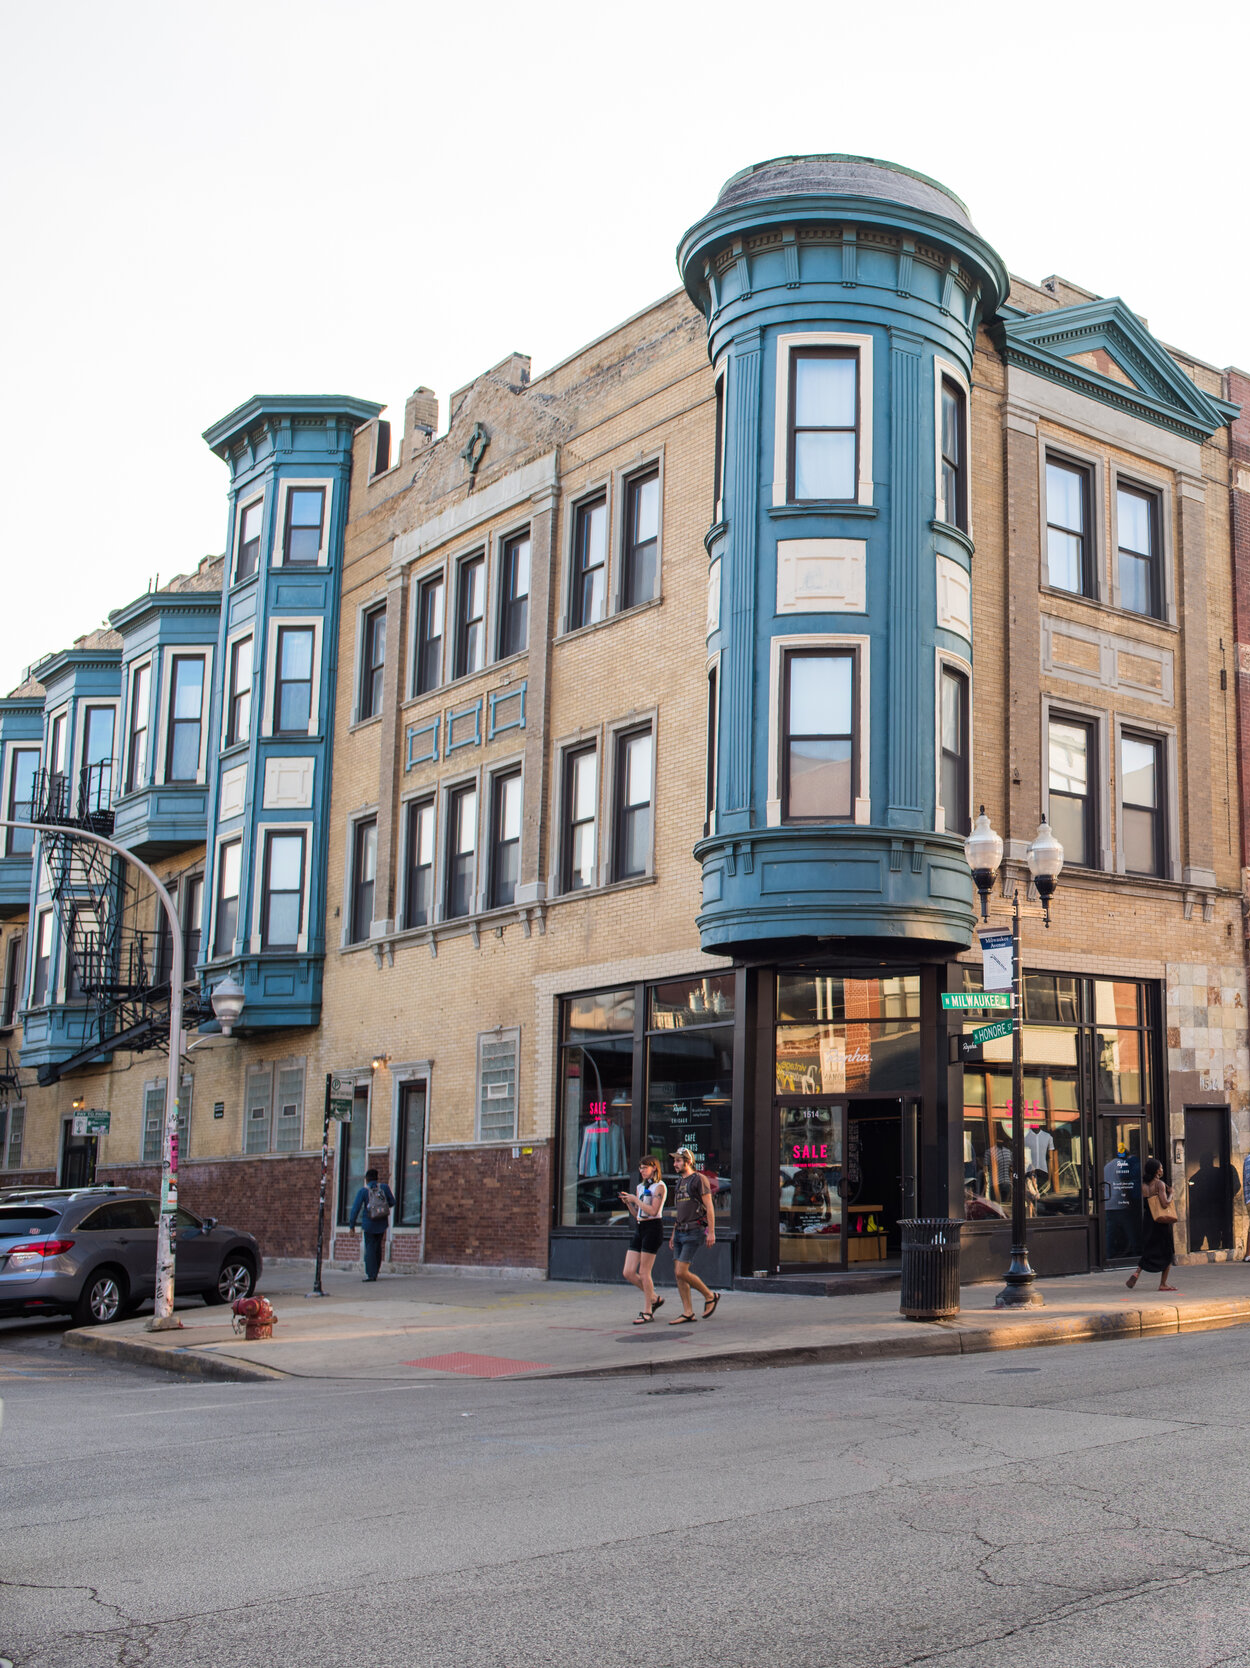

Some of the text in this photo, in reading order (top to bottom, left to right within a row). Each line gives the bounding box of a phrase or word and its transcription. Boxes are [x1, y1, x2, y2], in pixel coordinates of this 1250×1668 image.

[986, 936, 1009, 944] Milwaukee
[945, 997, 950, 1005] N
[951, 994, 1000, 1007] MILWAUKEE
[978, 1022, 1007, 1042] HONORE
[589, 1101, 607, 1115] SALE
[803, 1110, 820, 1119] 1514
[1006, 1099, 1041, 1117] SLE
[792, 1144, 828, 1159] SALE
